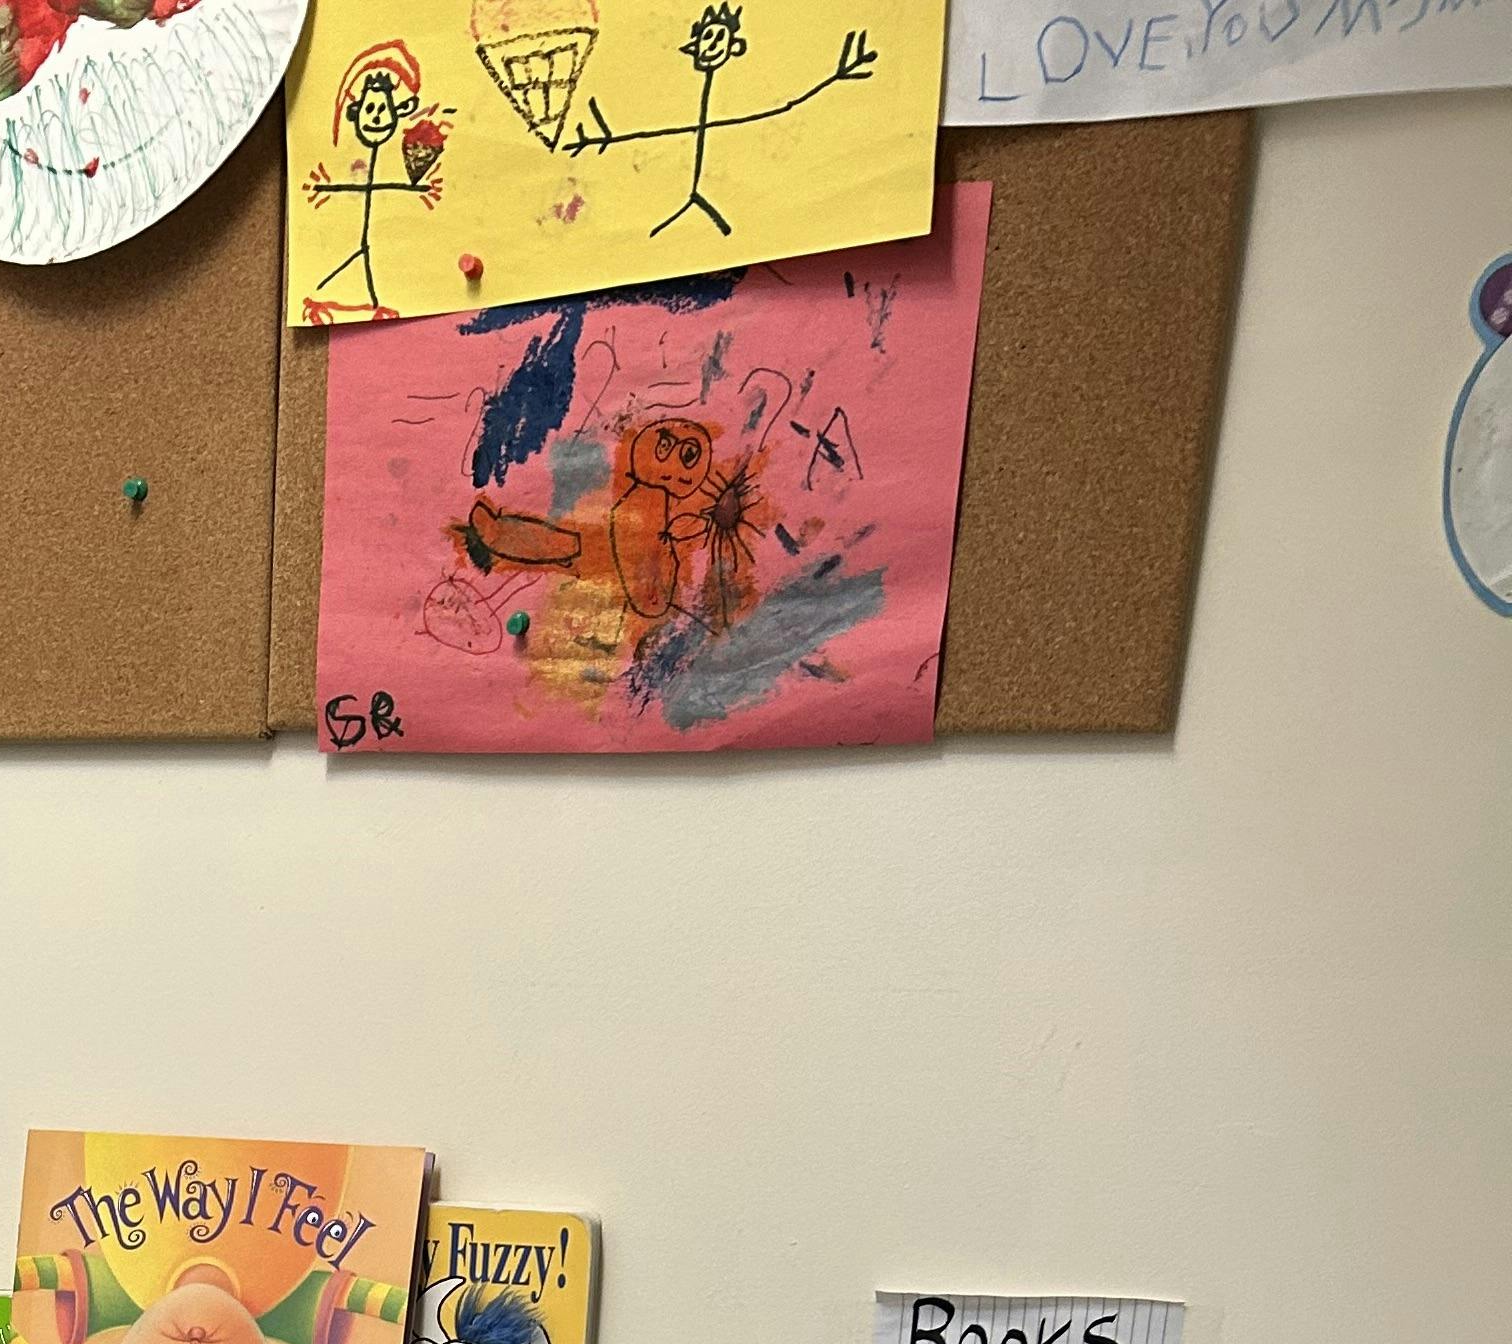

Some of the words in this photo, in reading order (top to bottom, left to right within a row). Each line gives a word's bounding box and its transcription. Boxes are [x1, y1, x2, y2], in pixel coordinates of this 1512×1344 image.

[49, 1182, 146, 1250] The
[142, 1160, 240, 1244] Way
[272, 1172, 379, 1270] Feel
[448, 1222, 569, 1304] Fuzzy!
